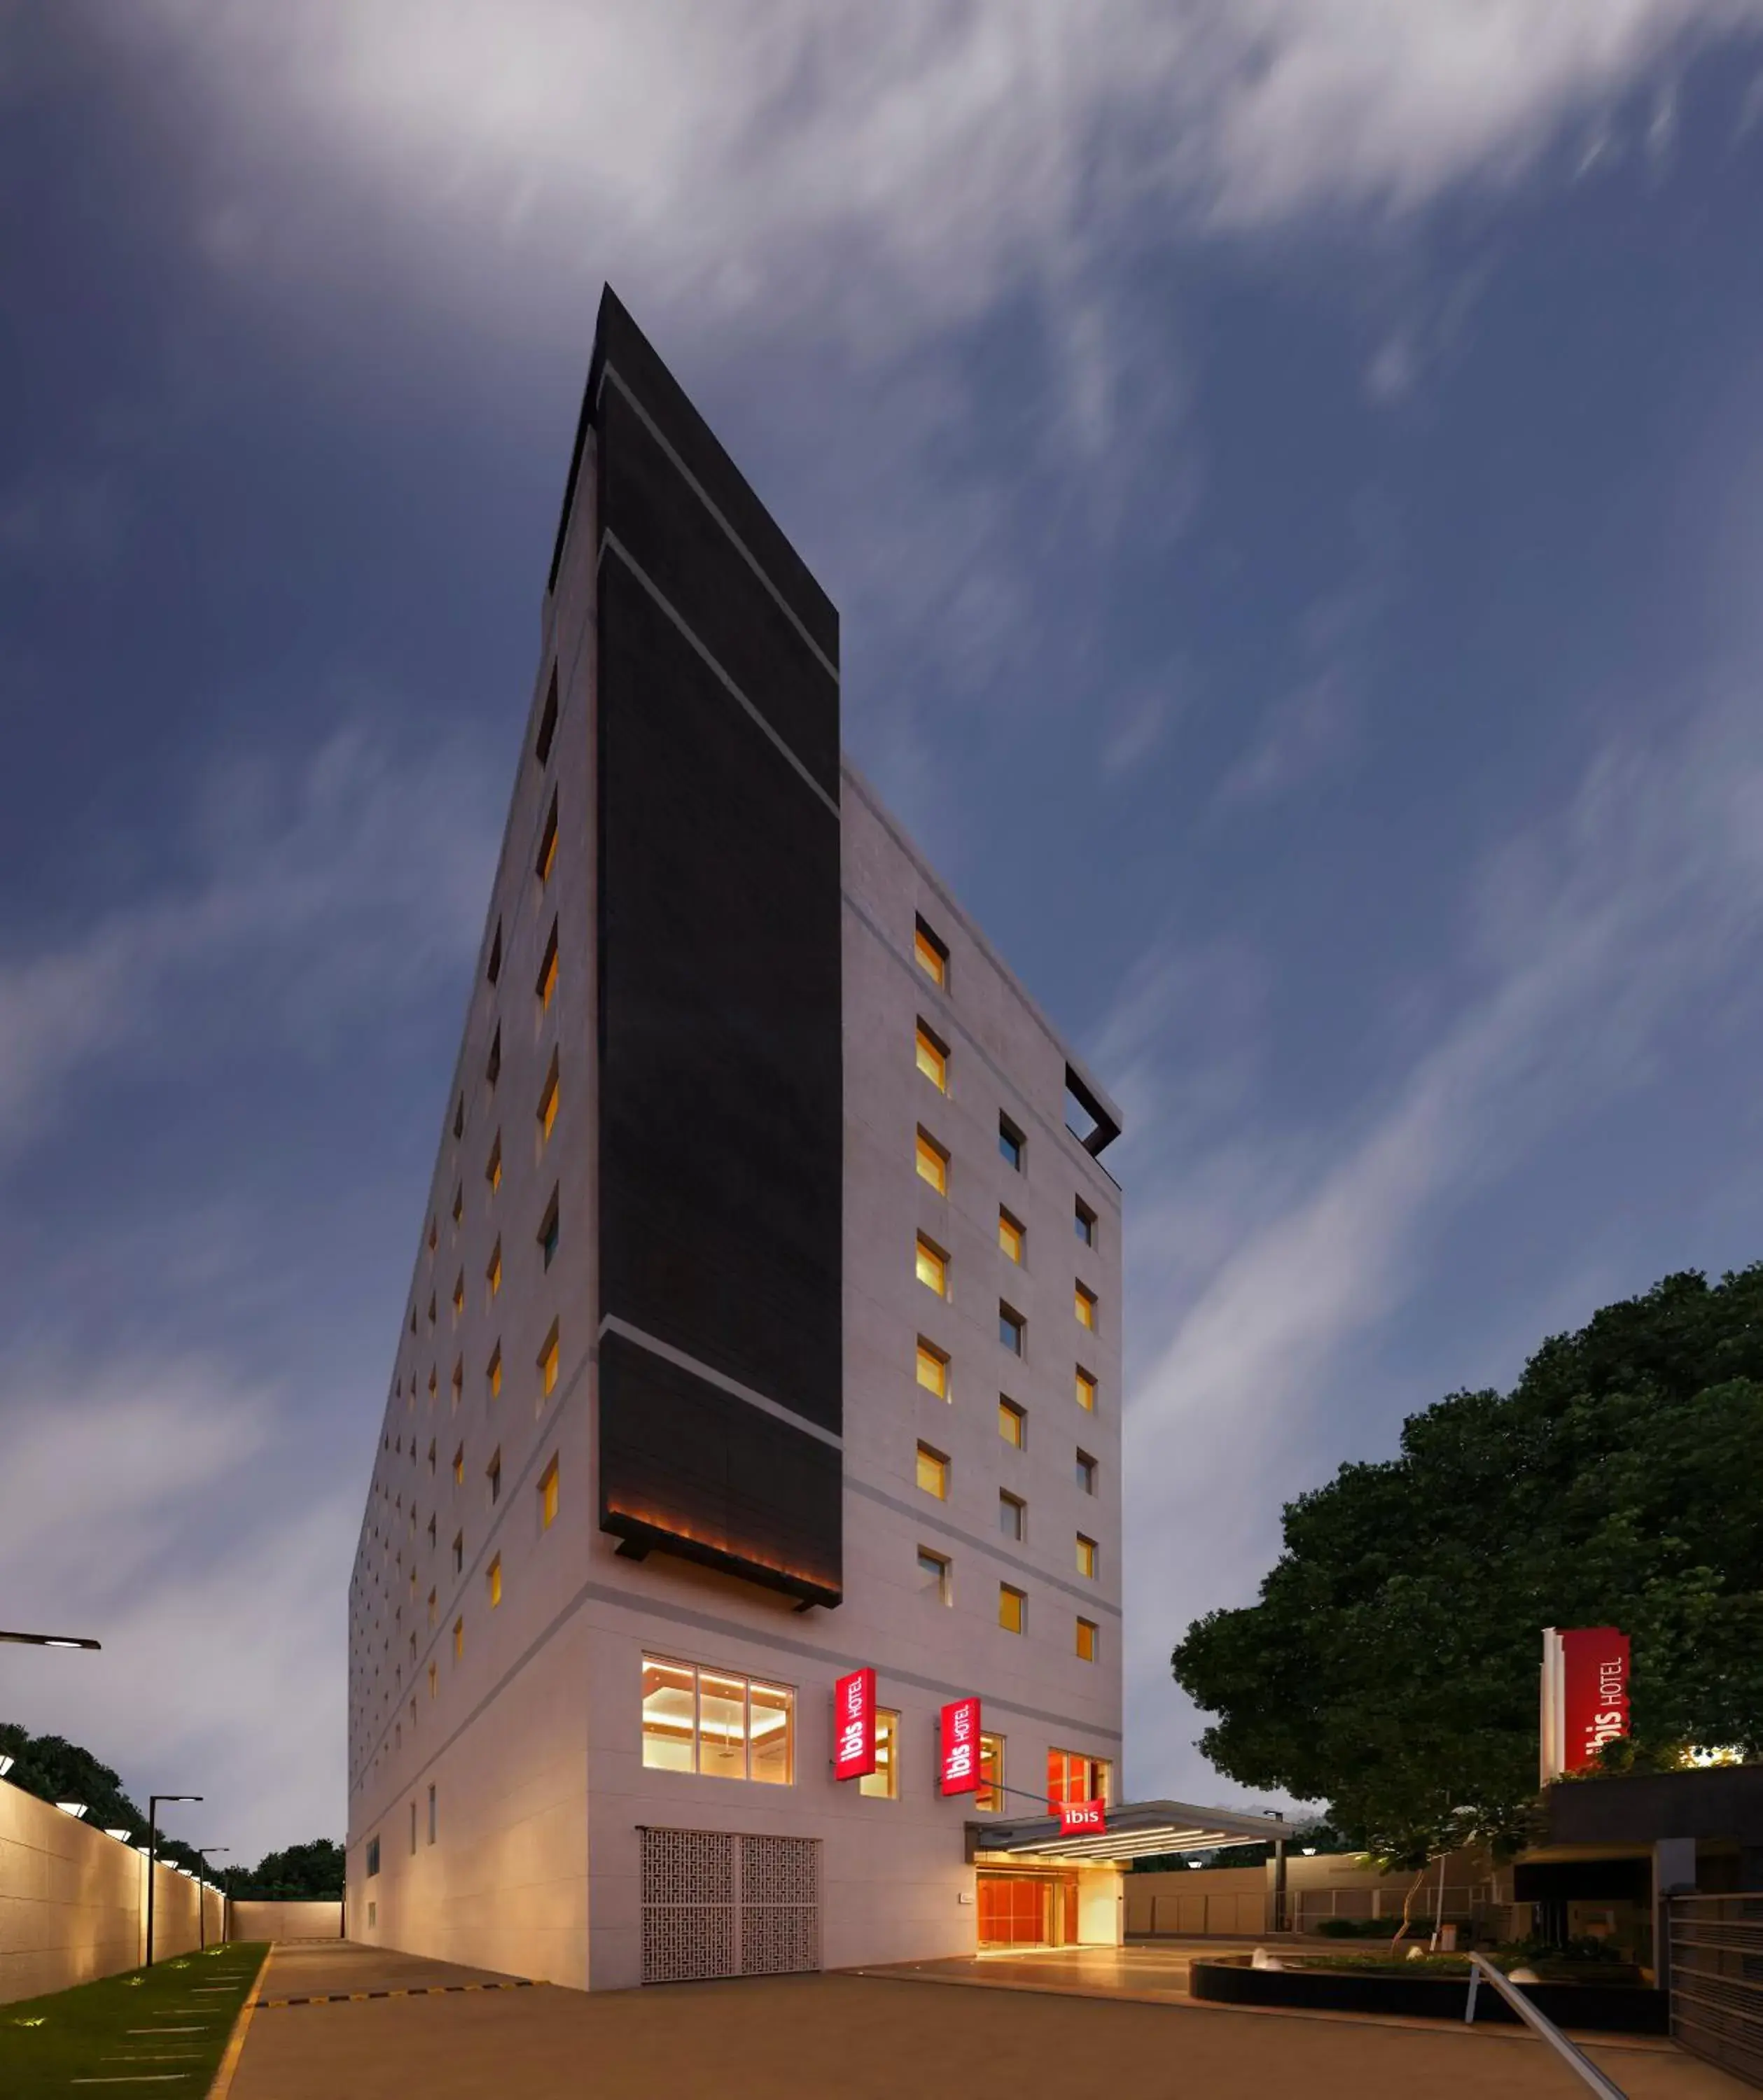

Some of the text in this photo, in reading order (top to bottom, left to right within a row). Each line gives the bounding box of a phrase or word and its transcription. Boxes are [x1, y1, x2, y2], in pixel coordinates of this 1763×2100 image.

[1600, 1657, 1622, 1707] HOTEL
[840, 1676, 863, 1762] ibis HOTEL
[946, 1704, 970, 1779] ibis HOTEL
[1066, 1809, 1099, 1824] ibis
